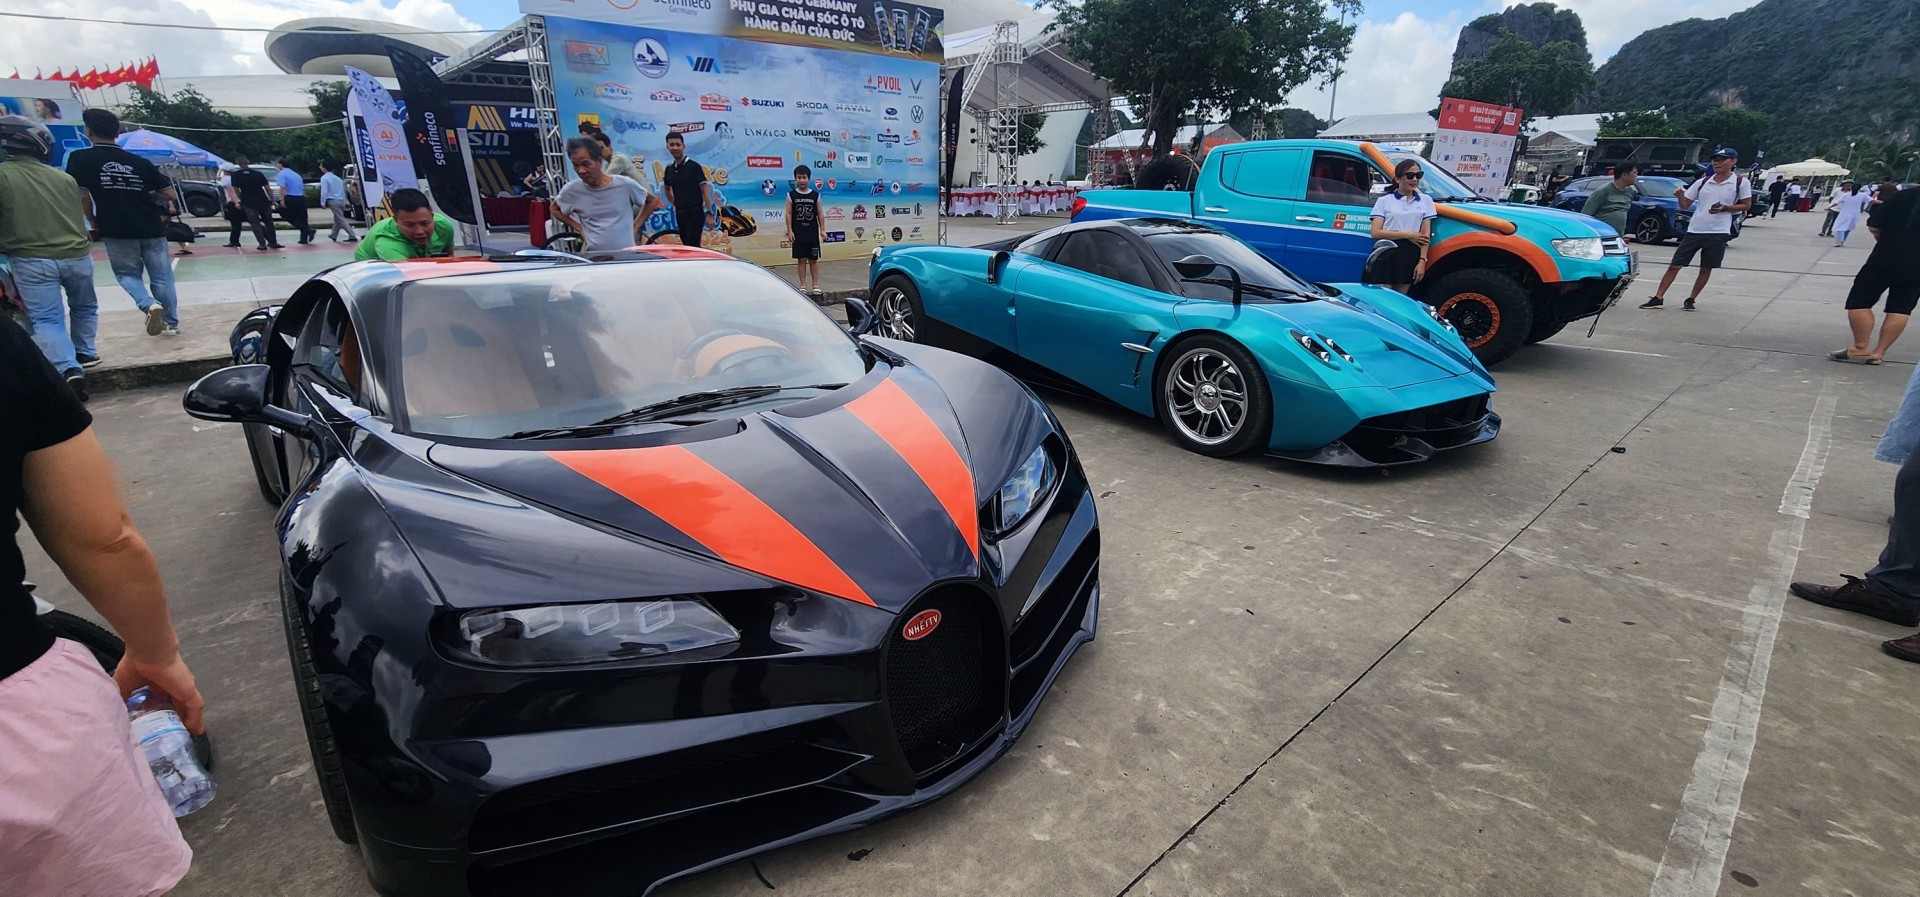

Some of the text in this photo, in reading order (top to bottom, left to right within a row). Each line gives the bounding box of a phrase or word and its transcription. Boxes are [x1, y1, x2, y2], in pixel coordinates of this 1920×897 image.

[730, 0, 756, 15] PHỤ
[758, 3, 780, 16] GIA
[781, 7, 815, 21] CHĂM
[817, 11, 839, 25] SÓC
[840, 14, 850, 27] Ô
[851, 16, 865, 29] TÔ
[744, 15, 855, 42] HÀNG ĐẦU CỦA ĐỨC
[877, 75, 901, 91] PVOIL
[751, 98, 784, 107] SUZUKI
[424, 111, 446, 166] senfineco
[794, 129, 831, 137] KUMHO
[814, 160, 833, 169] ICAR
[796, 204, 814, 221] 23
